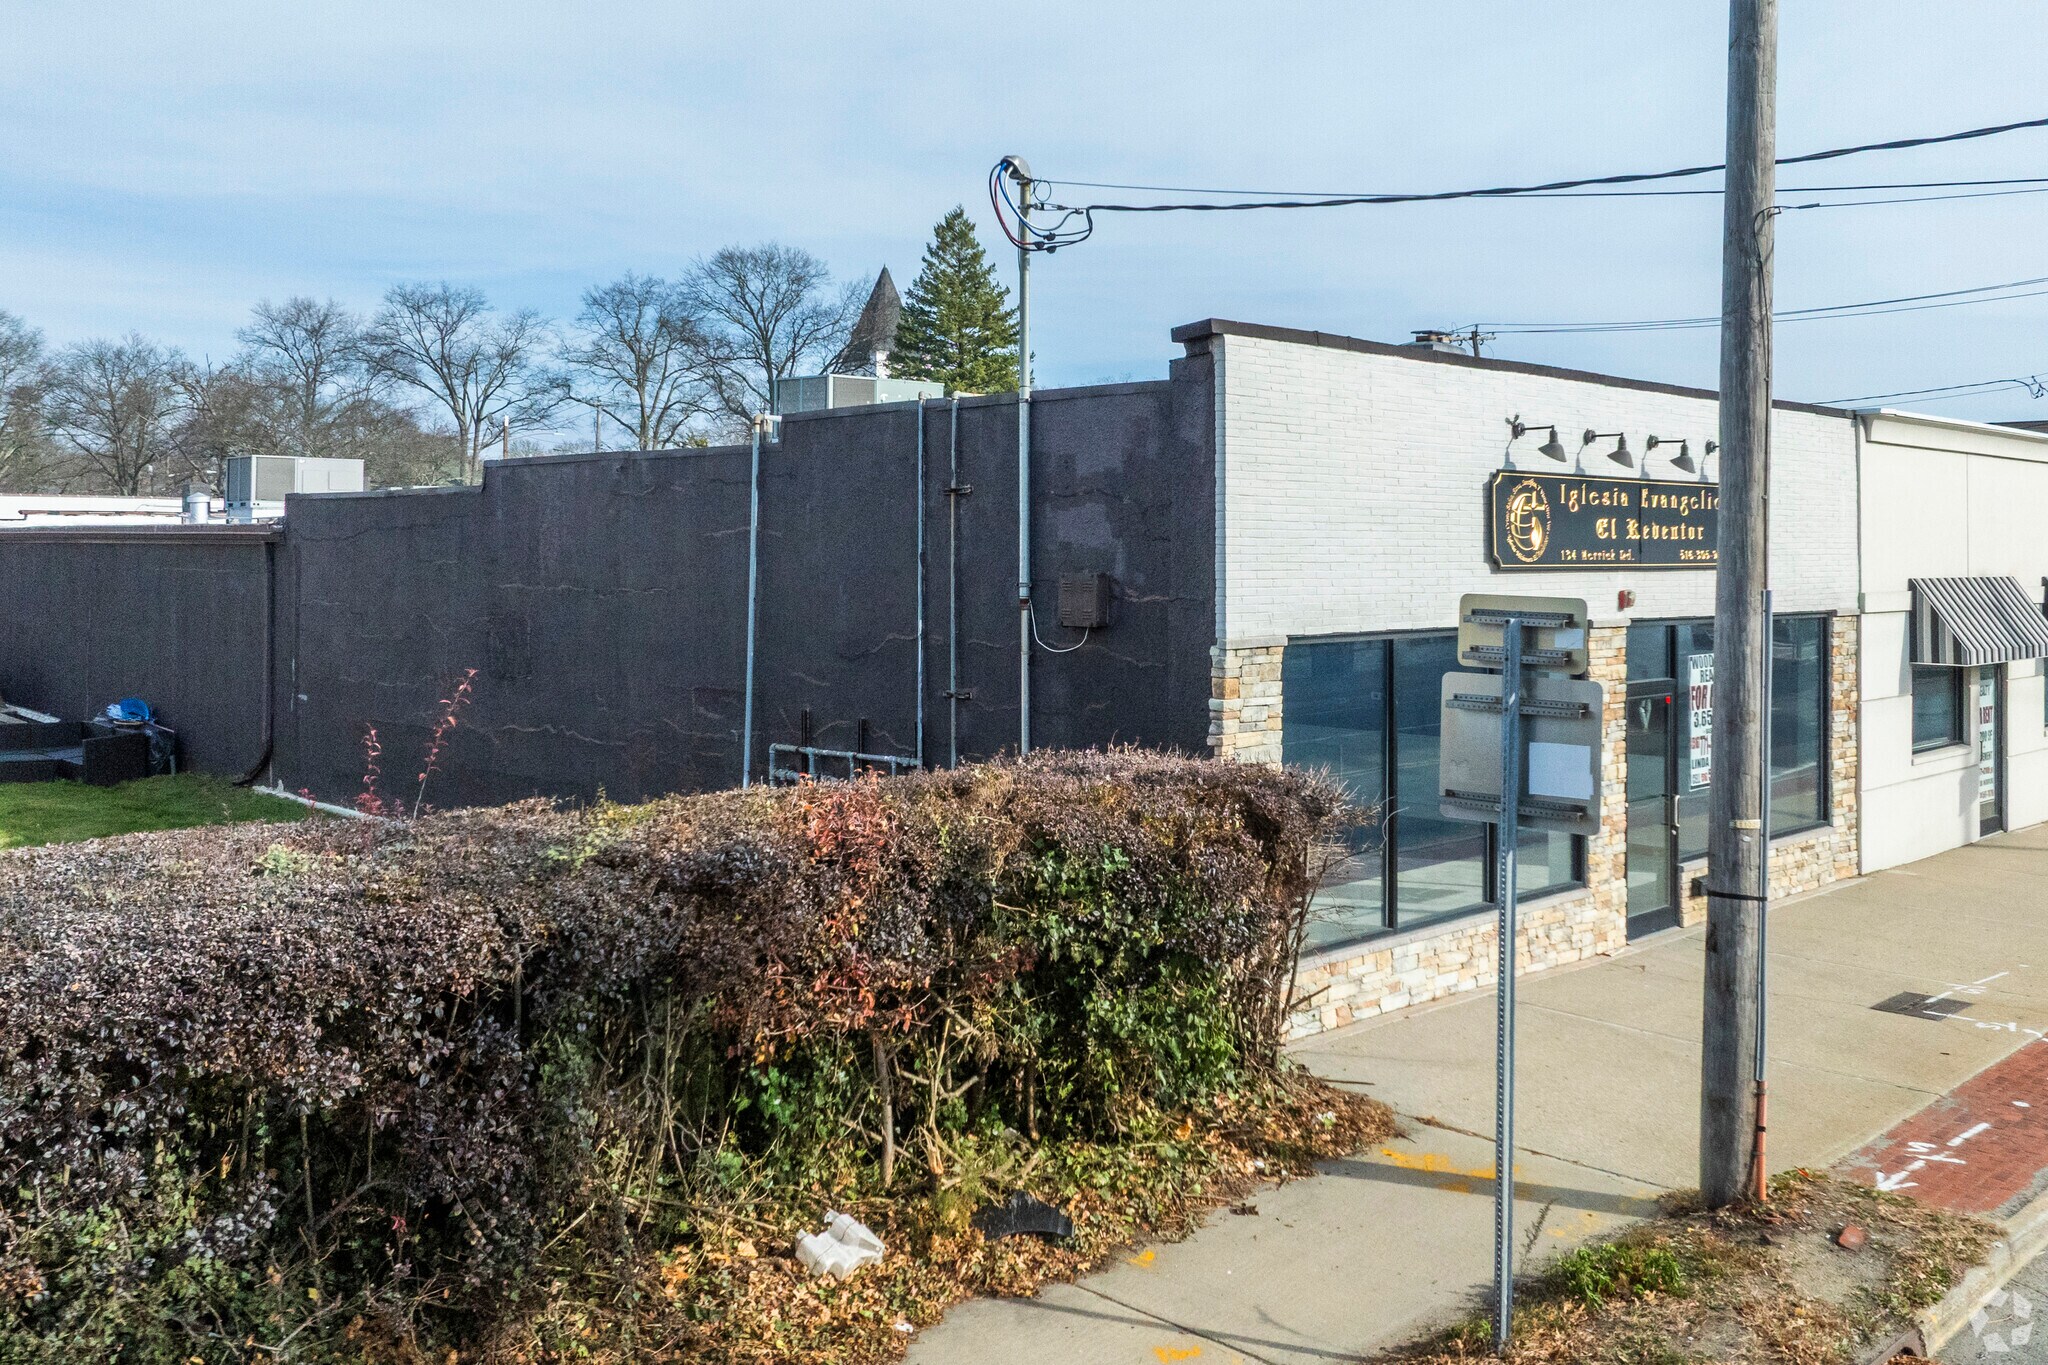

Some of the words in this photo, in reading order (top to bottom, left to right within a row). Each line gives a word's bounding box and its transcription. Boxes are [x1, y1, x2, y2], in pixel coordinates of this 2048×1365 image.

[1560, 483, 1629, 513] Iglesia
[1595, 517, 1618, 540] El
[1691, 684, 1708, 711] FOR
